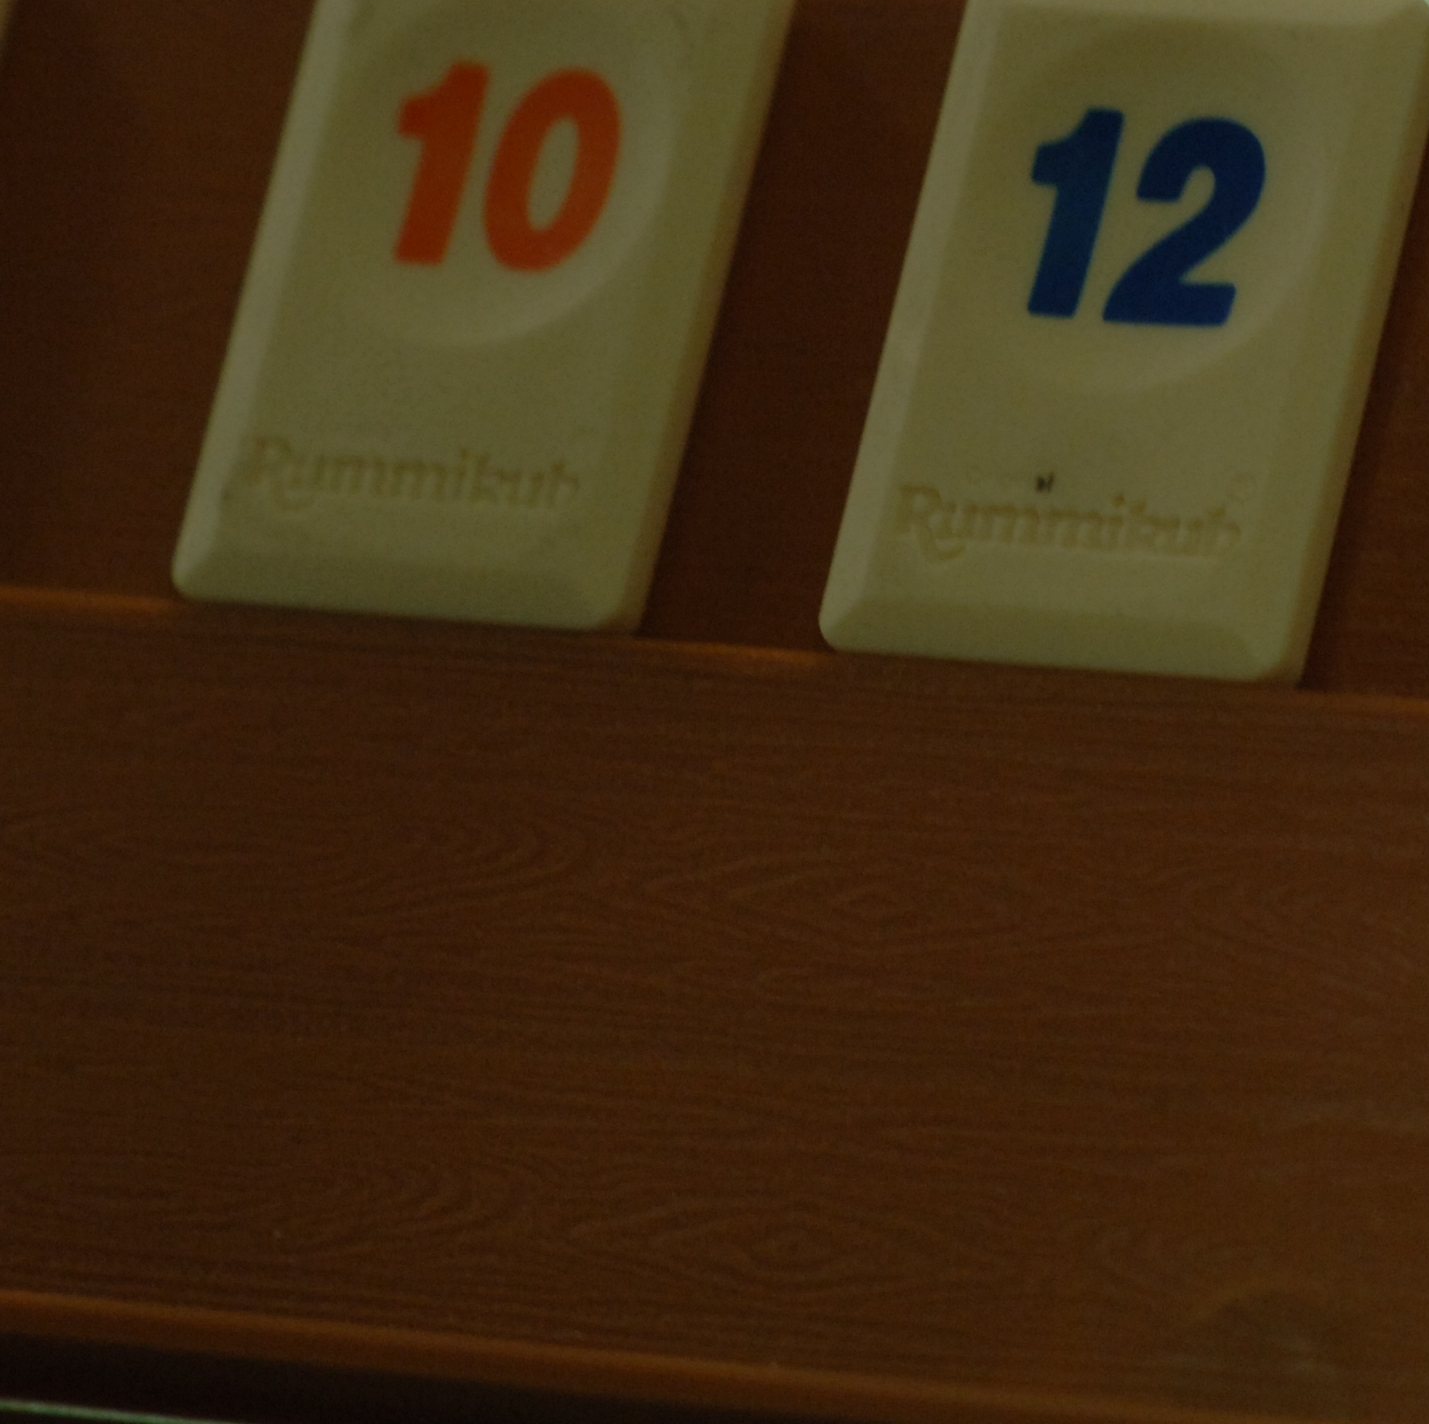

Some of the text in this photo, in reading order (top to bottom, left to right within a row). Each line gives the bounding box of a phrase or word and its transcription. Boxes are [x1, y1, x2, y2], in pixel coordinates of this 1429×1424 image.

[394, 60, 619, 271] 10
[1028, 107, 1266, 326] 12
[249, 434, 580, 514] Rummikub
[896, 482, 1241, 561] Rummikub
